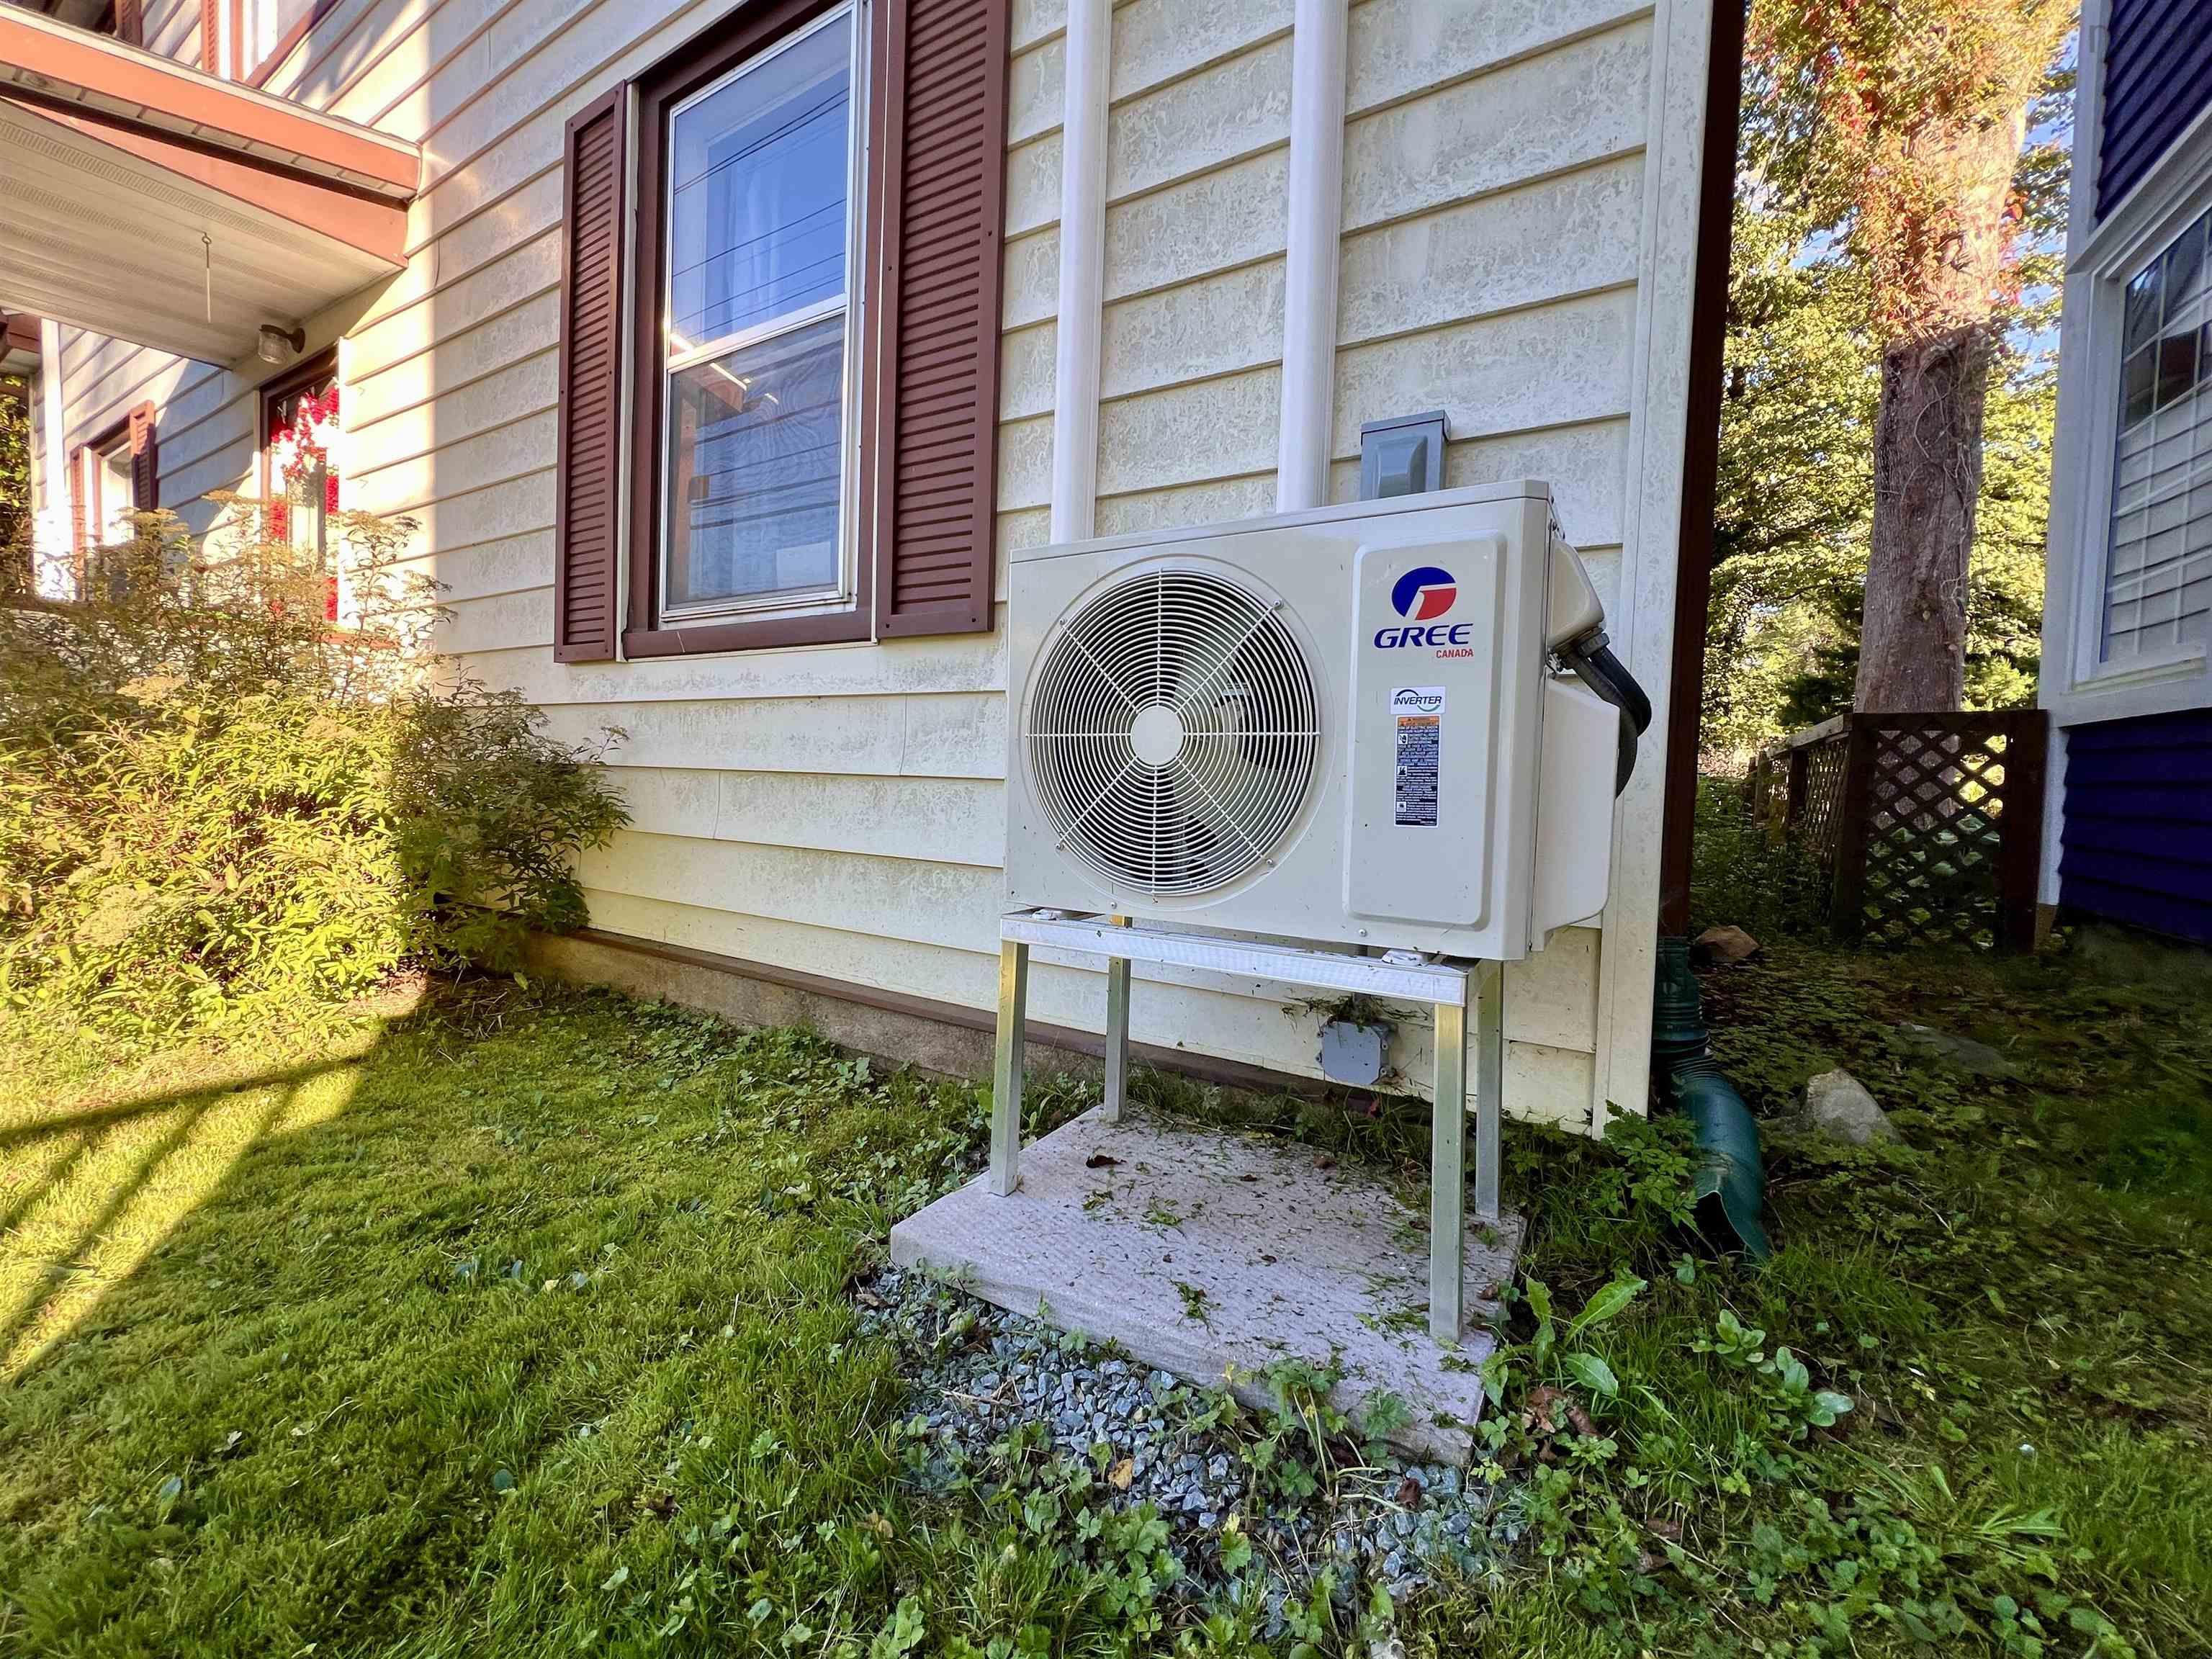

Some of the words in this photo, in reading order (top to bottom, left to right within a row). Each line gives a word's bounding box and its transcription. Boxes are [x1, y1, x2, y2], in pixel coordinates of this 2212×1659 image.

[1375, 624, 1473, 648] GREE
[1436, 649, 1474, 658] CANADA
[1394, 696, 1442, 705] INVERTER
